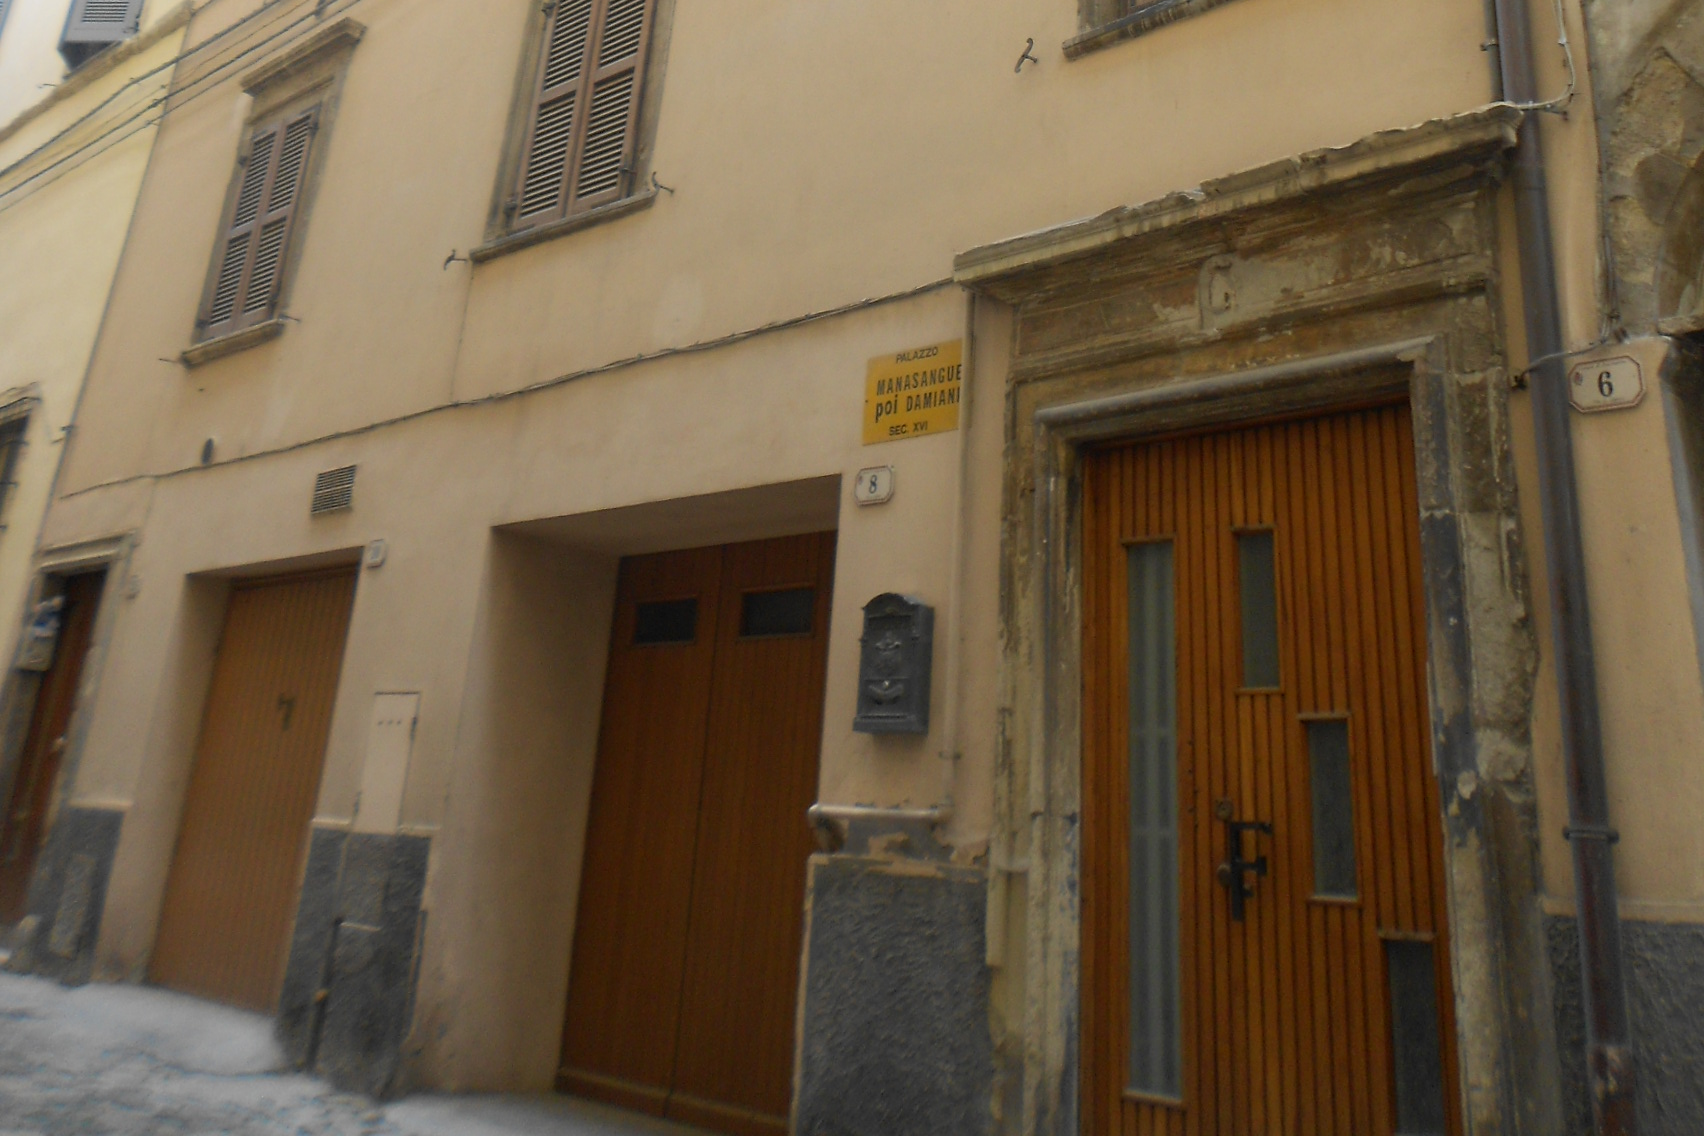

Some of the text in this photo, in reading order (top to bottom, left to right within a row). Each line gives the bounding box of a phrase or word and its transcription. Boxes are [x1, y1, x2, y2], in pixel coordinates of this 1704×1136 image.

[896, 346, 939, 364] PALAZZO
[876, 364, 962, 396] MANASANGUE
[1598, 371, 1613, 397] 6
[875, 387, 960, 423] poi DAMIANI
[913, 420, 928, 433] XVI
[869, 474, 878, 494] 8
